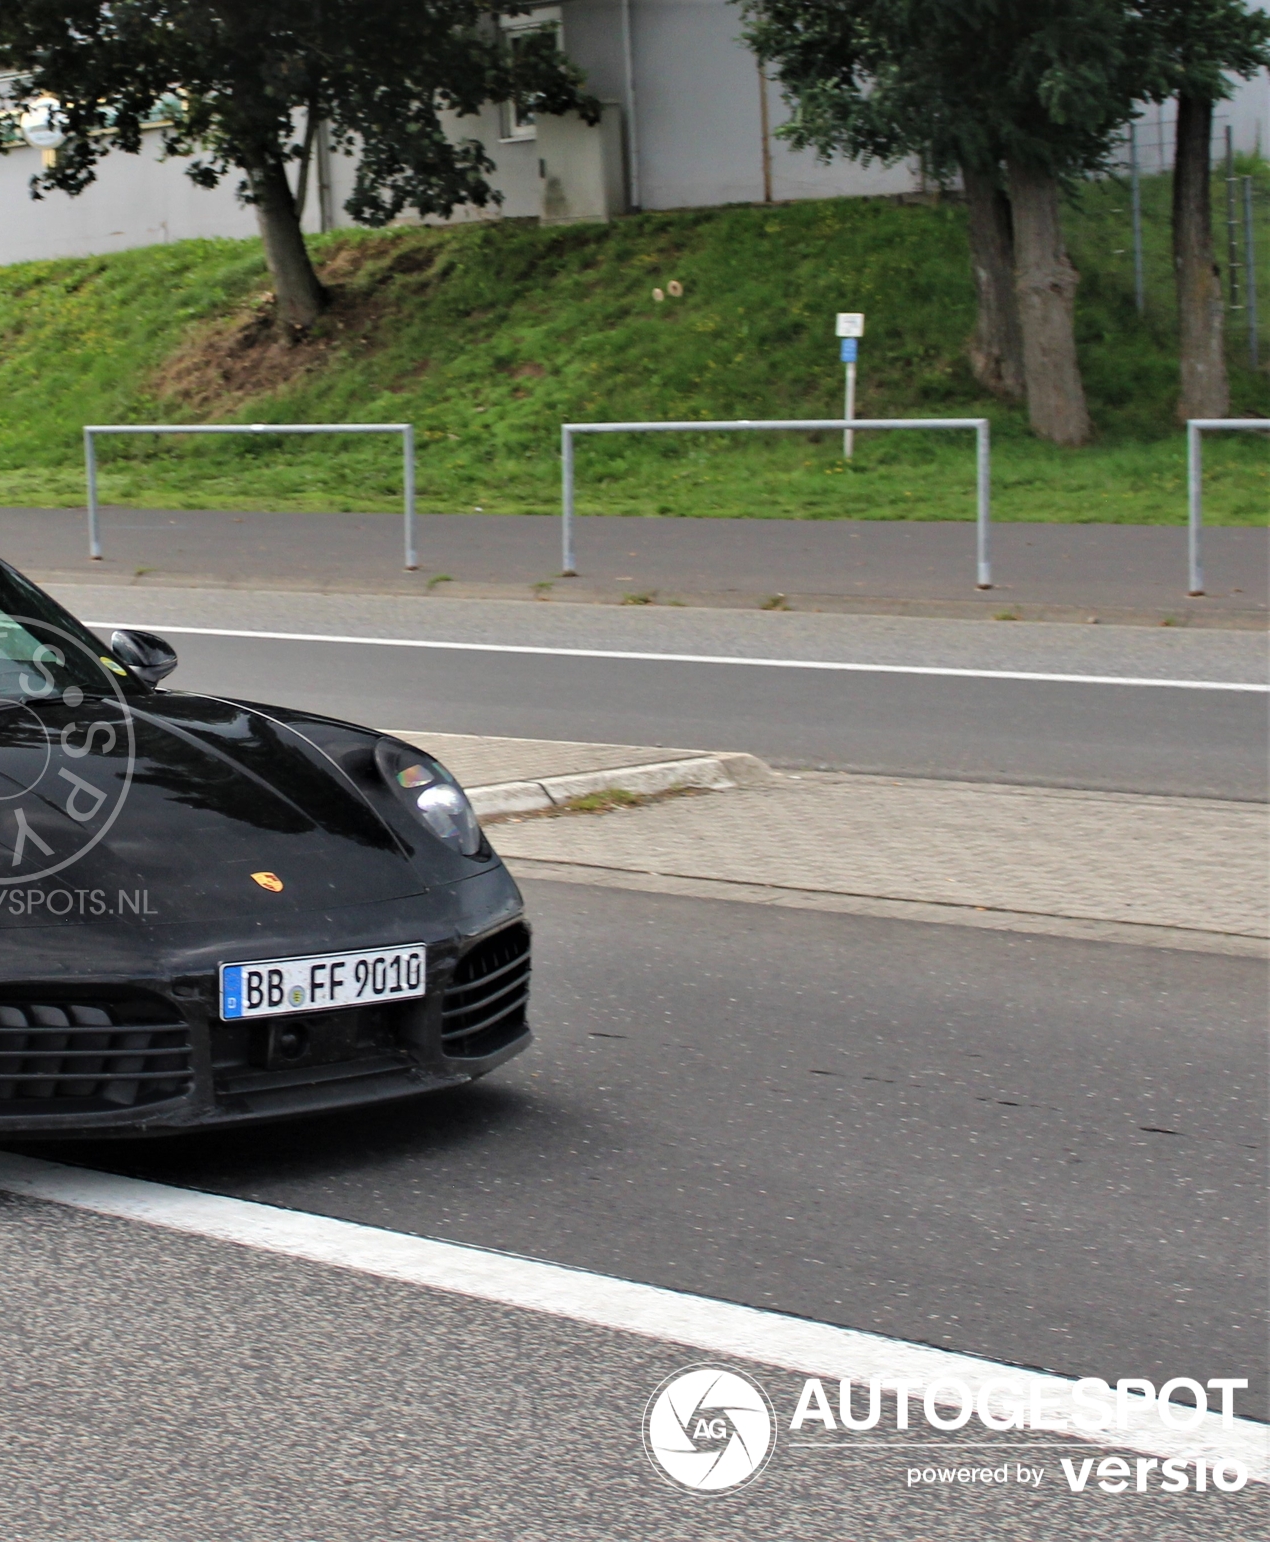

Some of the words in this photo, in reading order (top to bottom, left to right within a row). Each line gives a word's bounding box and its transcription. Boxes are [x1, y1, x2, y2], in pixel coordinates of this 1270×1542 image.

[246, 968, 284, 1010] BB
[310, 962, 346, 1003] FF
[355, 953, 420, 997] 9010
